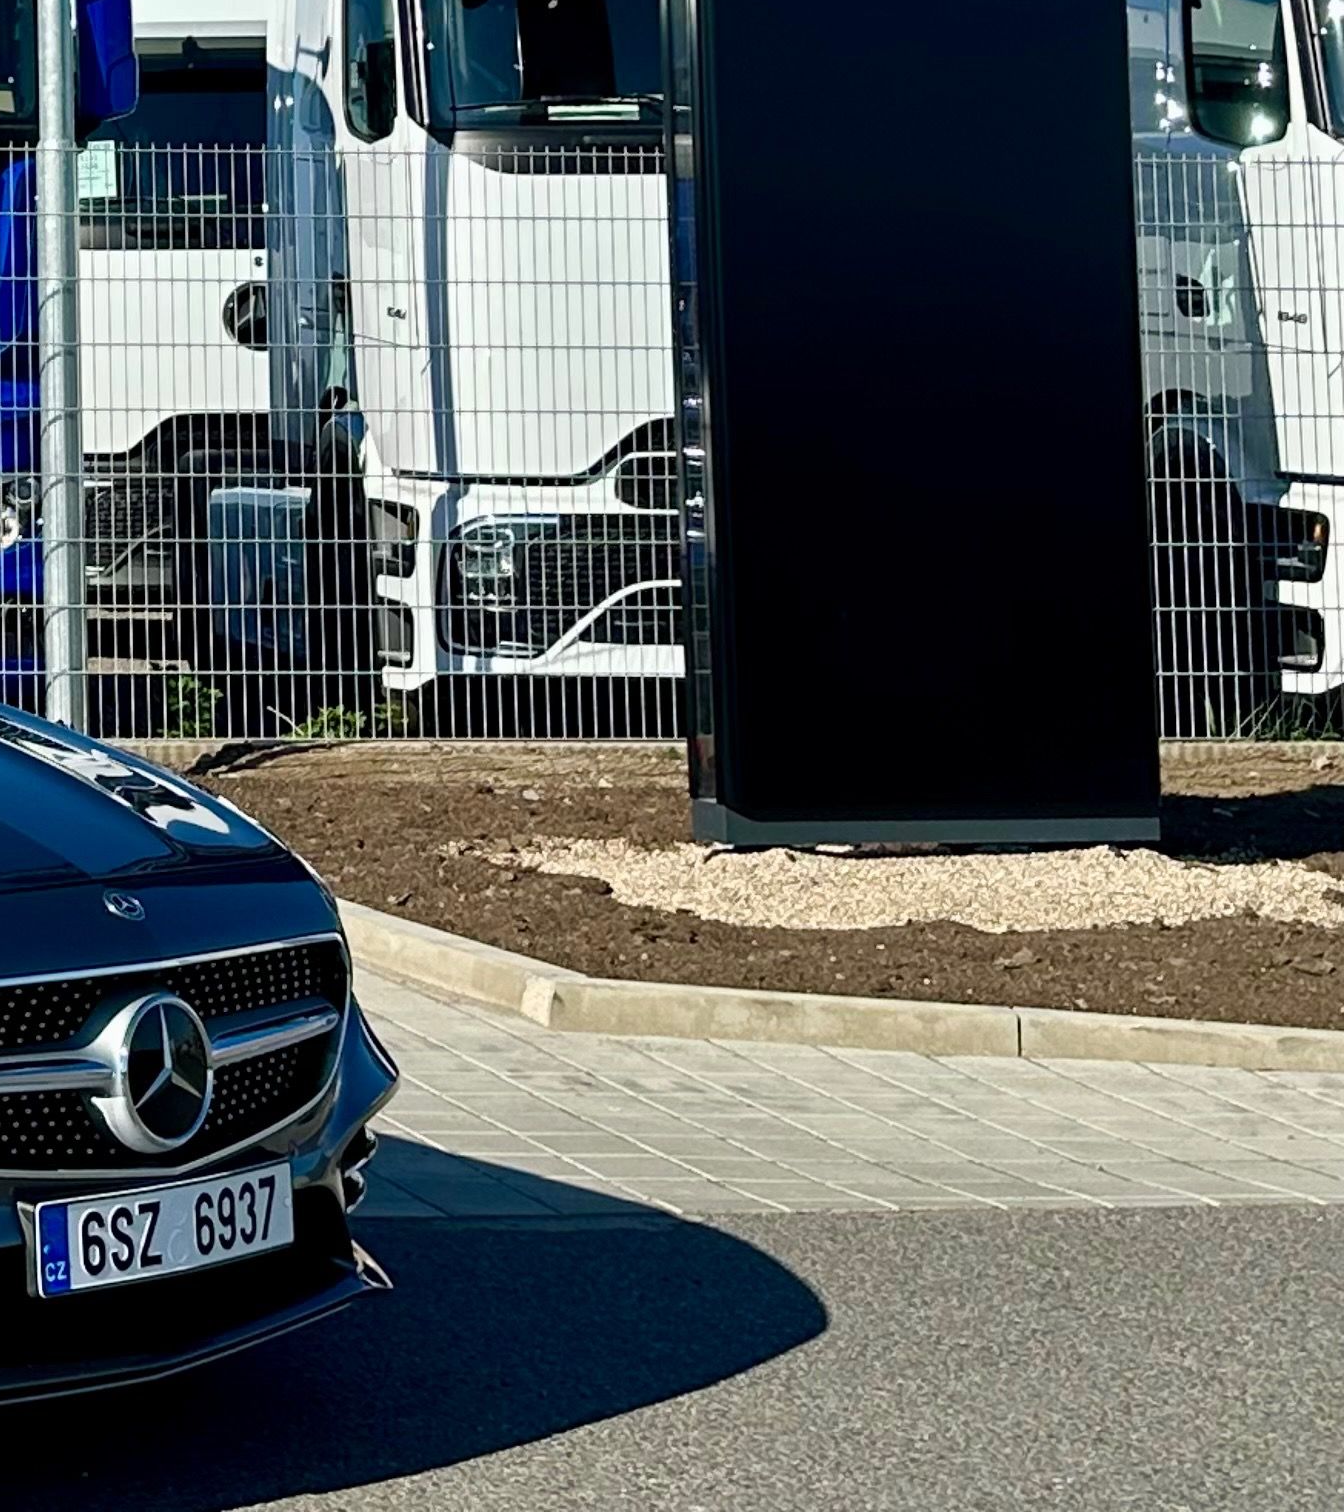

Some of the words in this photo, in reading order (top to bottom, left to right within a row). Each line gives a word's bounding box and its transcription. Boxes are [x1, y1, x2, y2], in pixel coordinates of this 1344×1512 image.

[81, 1201, 162, 1276] 6SZ
[195, 1175, 275, 1255] 6937
[45, 1262, 67, 1281] CZ
